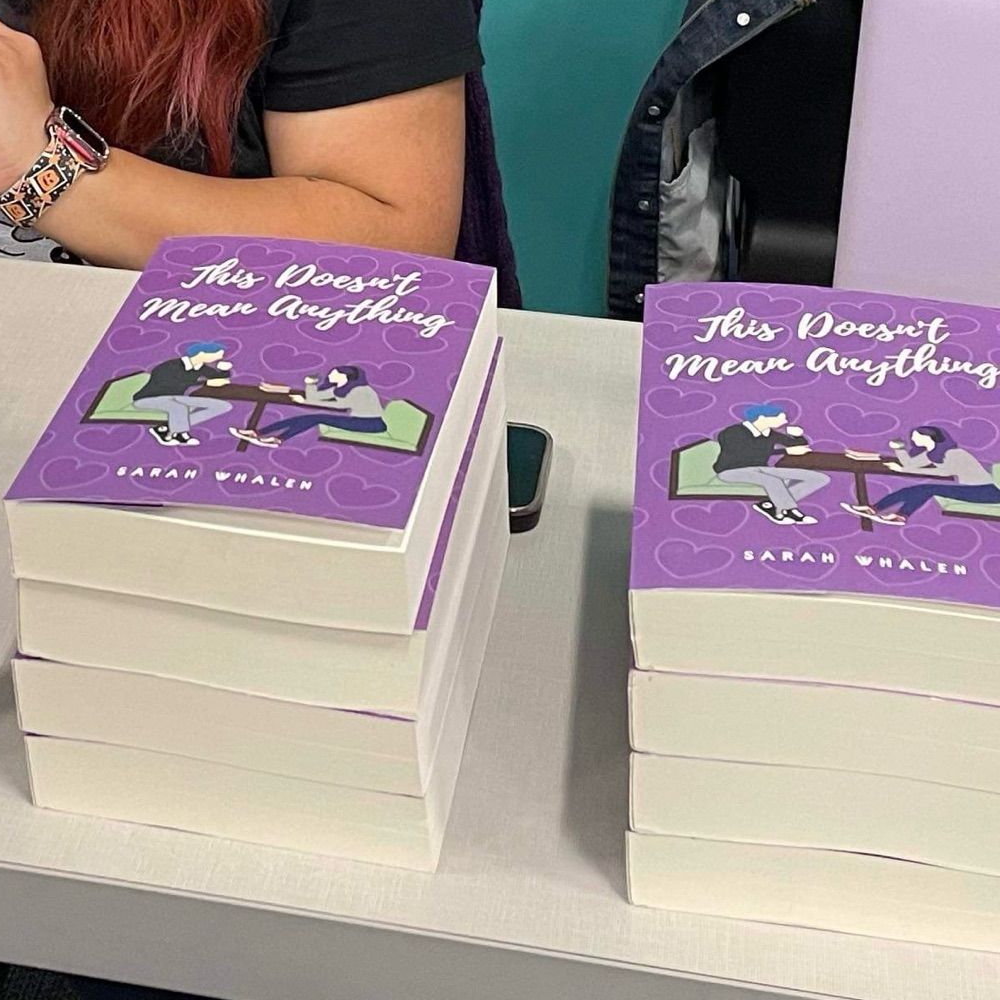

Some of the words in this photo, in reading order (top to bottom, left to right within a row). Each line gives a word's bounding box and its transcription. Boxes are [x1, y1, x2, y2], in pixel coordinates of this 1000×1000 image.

[180, 257, 265, 290] This
[275, 263, 424, 296] Doesn't
[138, 296, 258, 323] Mean
[266, 293, 456, 338] Anything
[694, 307, 784, 343] This
[797, 312, 951, 345] Doesn't
[665, 353, 795, 383] Mean
[805, 343, 1000, 389] Anything
[116, 466, 199, 481] SARAH
[214, 471, 314, 491] WHALEN
[743, 550, 836, 564] SARAH
[855, 554, 967, 576] WHALEN
